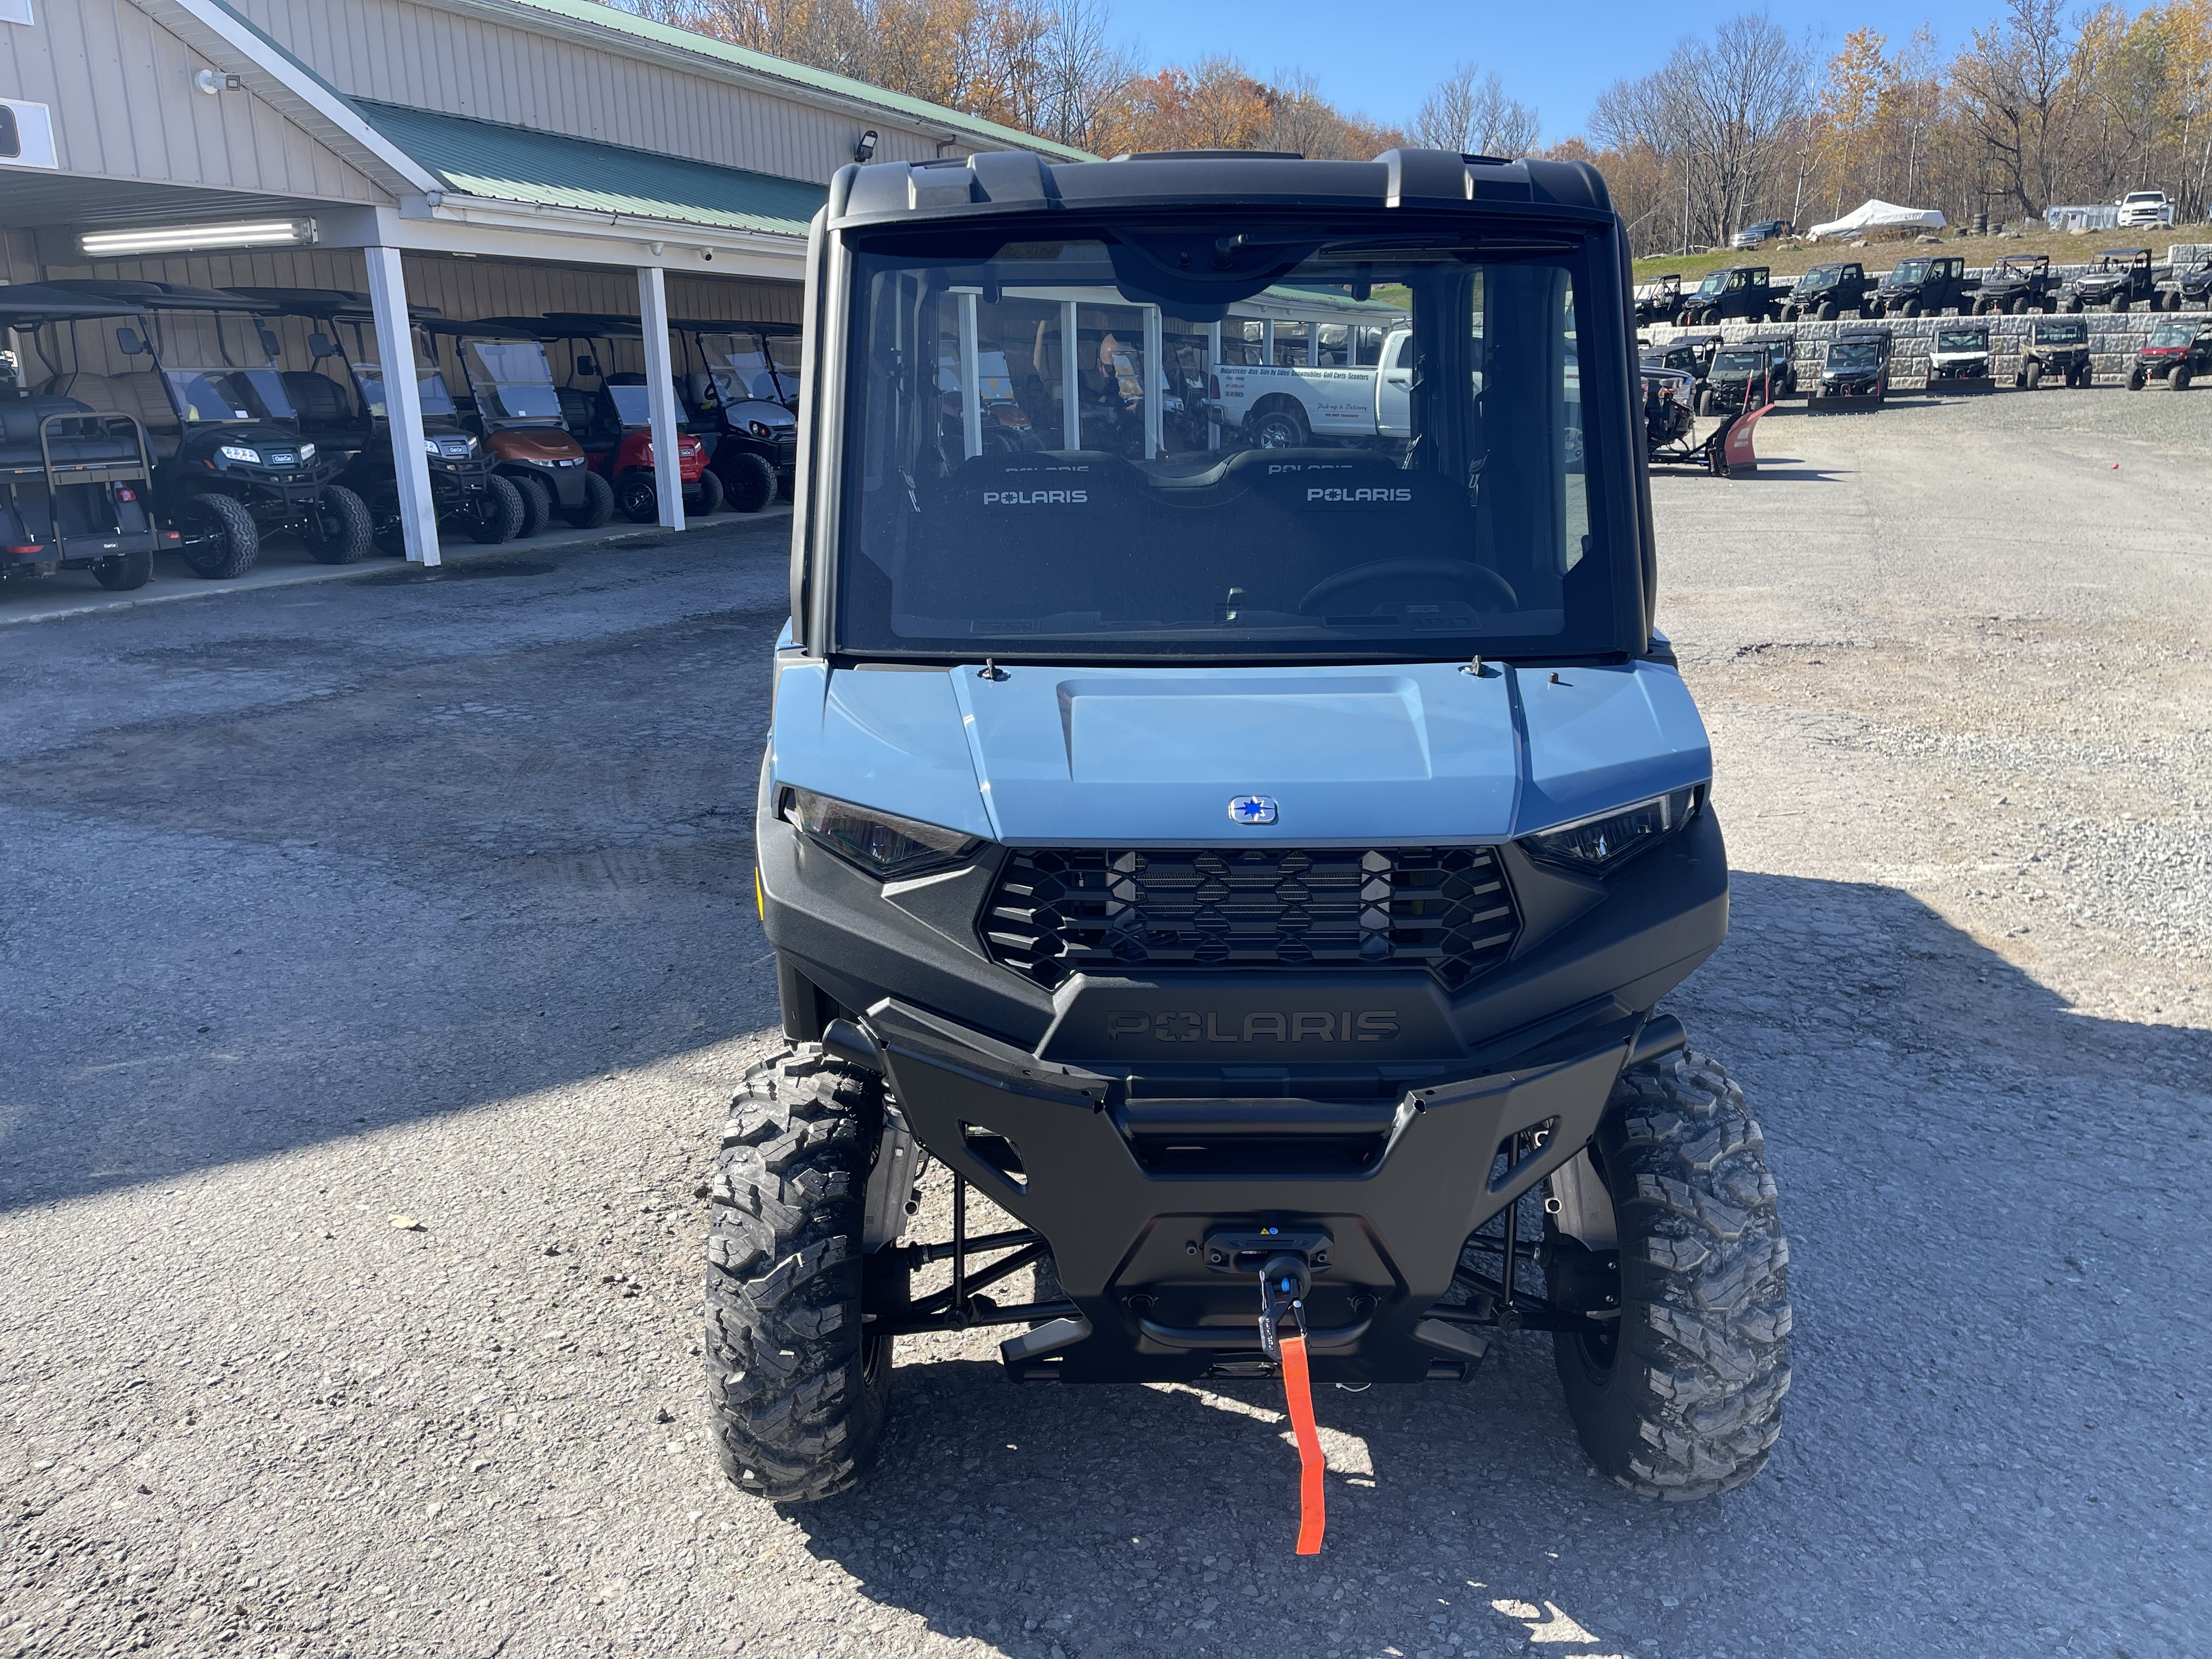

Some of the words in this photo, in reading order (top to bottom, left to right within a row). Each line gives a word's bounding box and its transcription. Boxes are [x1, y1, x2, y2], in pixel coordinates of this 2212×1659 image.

[1317, 403, 1338, 411] Pick-up
[984, 490, 1088, 505] POLARIS
[1307, 488, 1412, 501] POLARIS
[1107, 1011, 1402, 1042] POLARIS
